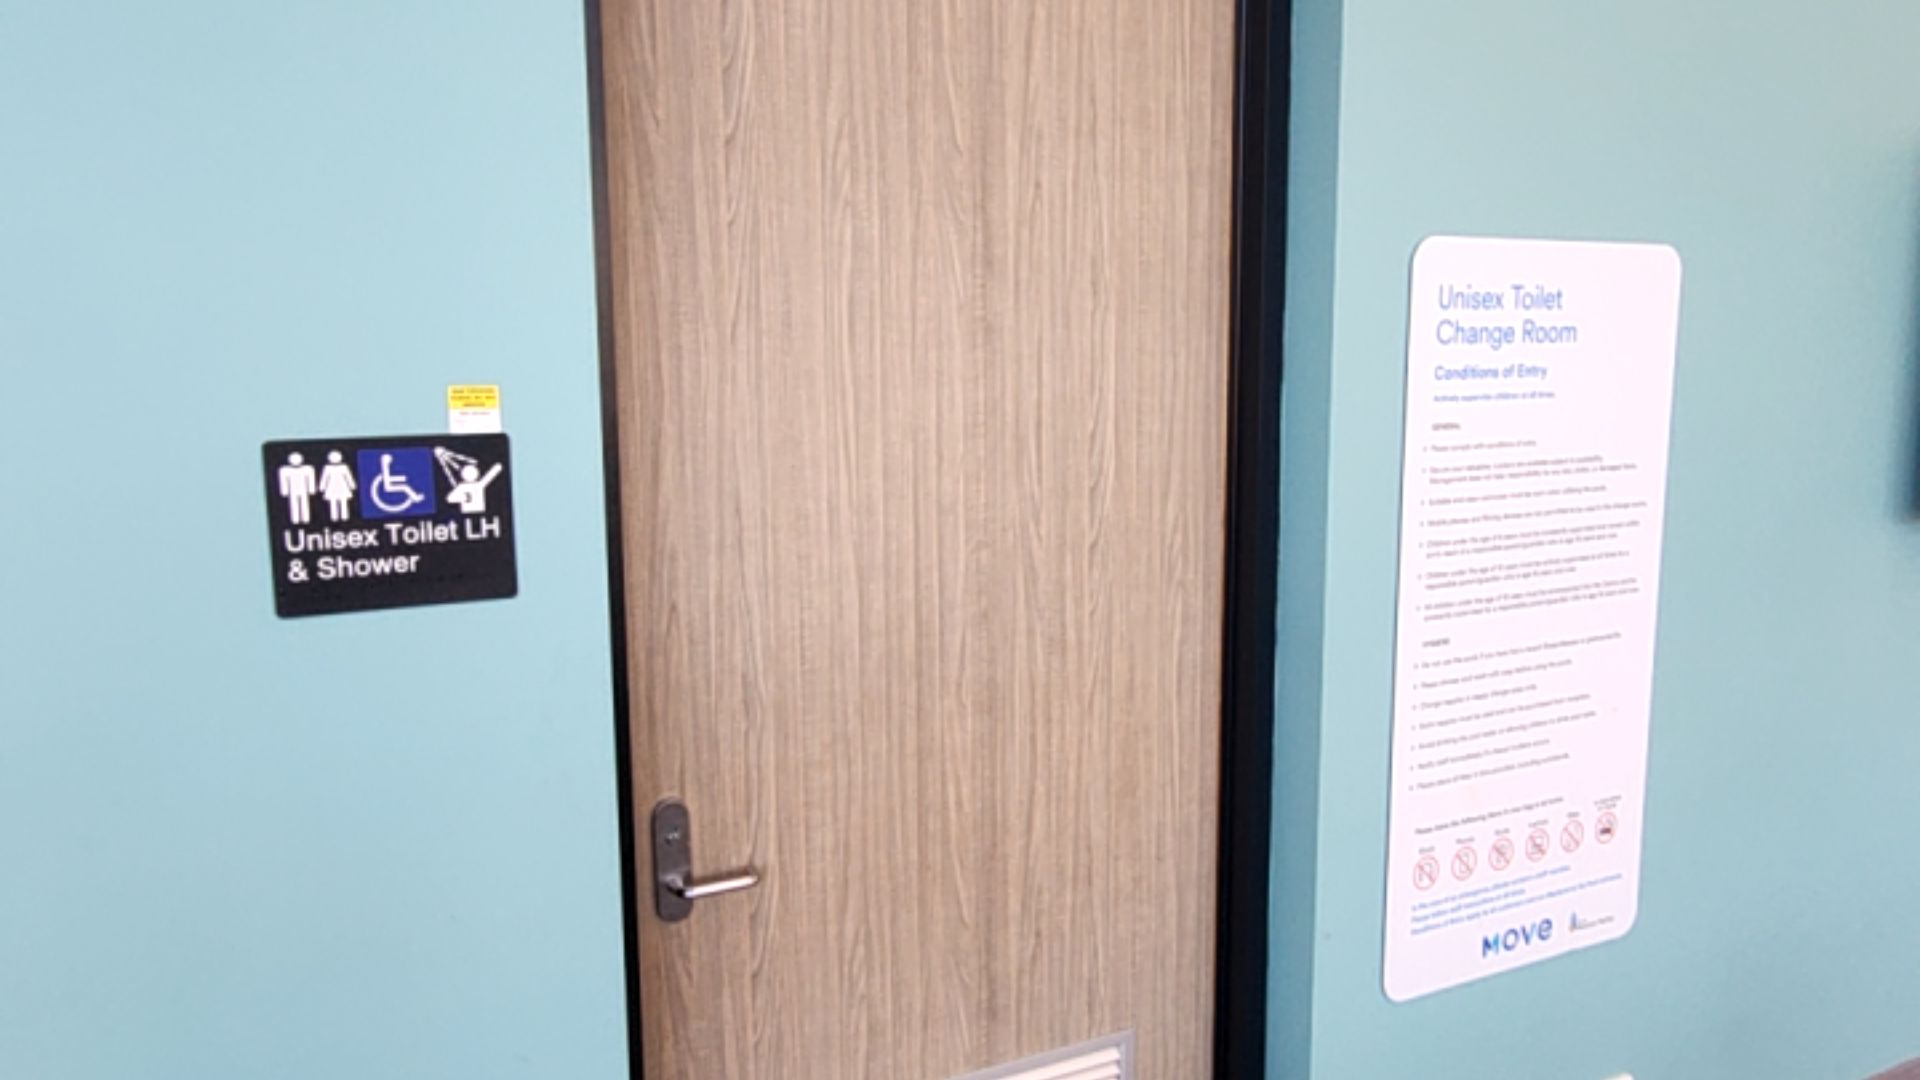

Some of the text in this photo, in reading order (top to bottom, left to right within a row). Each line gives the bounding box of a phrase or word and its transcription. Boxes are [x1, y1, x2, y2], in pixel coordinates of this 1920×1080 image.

[1438, 284, 1563, 310] Unisex Toilet
[1436, 318, 1577, 350] Change Room
[1434, 363, 1548, 380] Conditions of Entry
[284, 517, 500, 553] Unisex Toilet LH
[287, 554, 420, 583] & Shower
